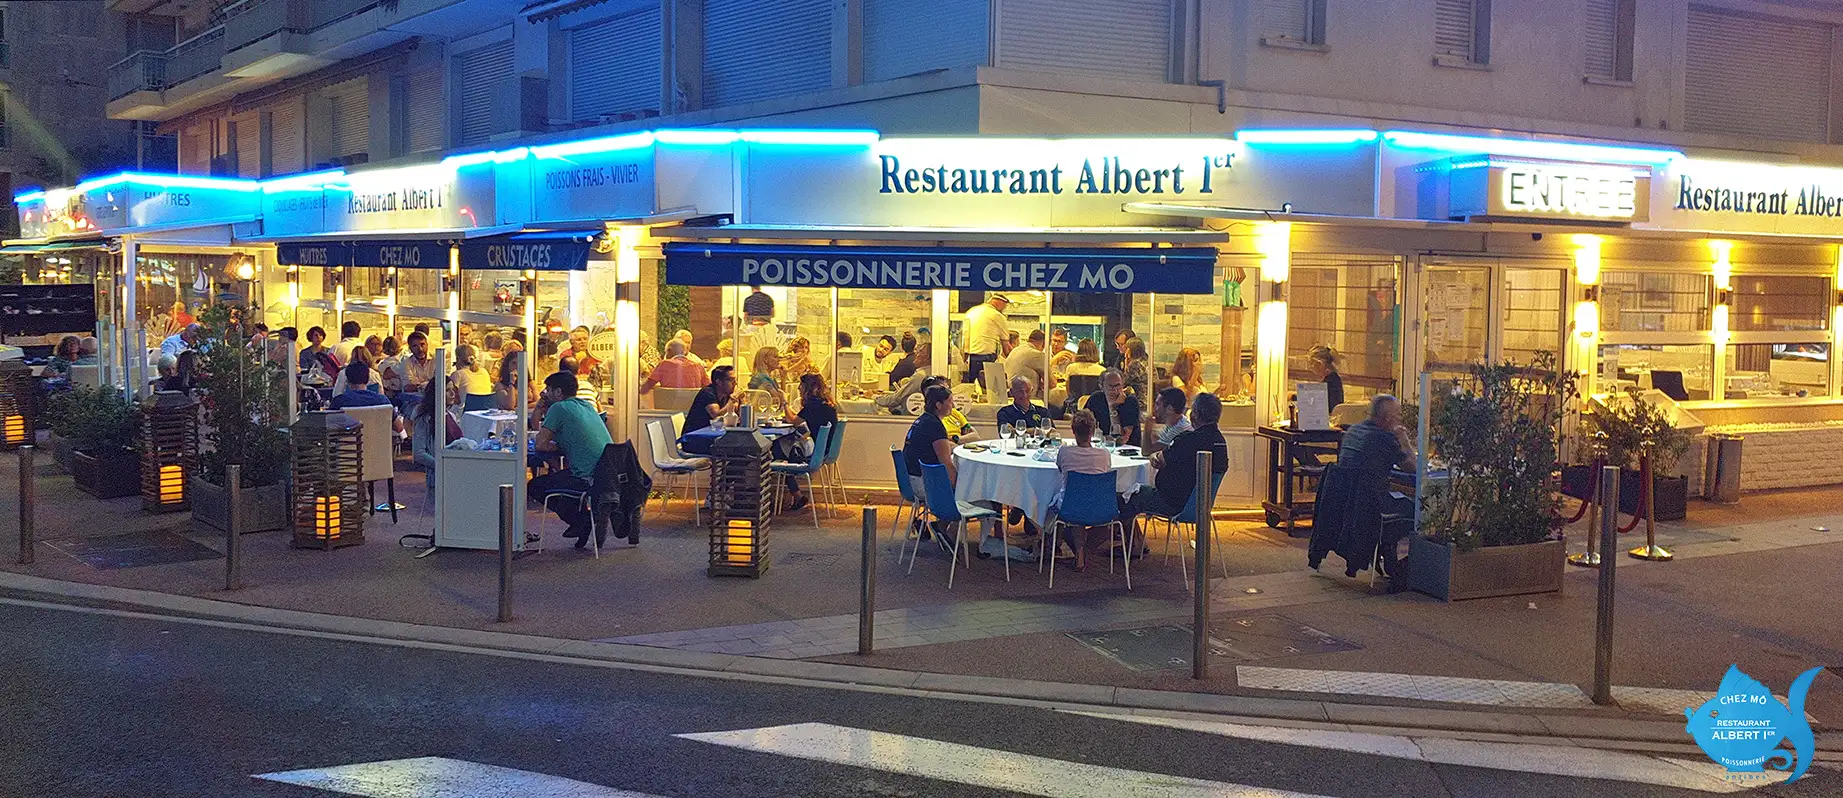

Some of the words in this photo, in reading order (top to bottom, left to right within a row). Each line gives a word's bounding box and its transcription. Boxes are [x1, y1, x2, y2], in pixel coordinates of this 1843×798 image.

[545, 169, 581, 190] POISSONS
[582, 167, 605, 188] FRAIS
[610, 163, 639, 185] VIVIER
[878, 154, 1064, 195] Restaurant
[1074, 155, 1185, 195] Albert
[347, 189, 398, 215] Restaurant
[401, 185, 434, 211] Albert
[1676, 174, 1789, 216] Restaurant
[299, 247, 328, 265] HUITRES
[379, 246, 402, 265] CHEZ
[403, 246, 420, 266] MO
[742, 258, 971, 288] POISSONNERIE
[982, 261, 1069, 289] CHEZ
[1078, 263, 1134, 290] MO
